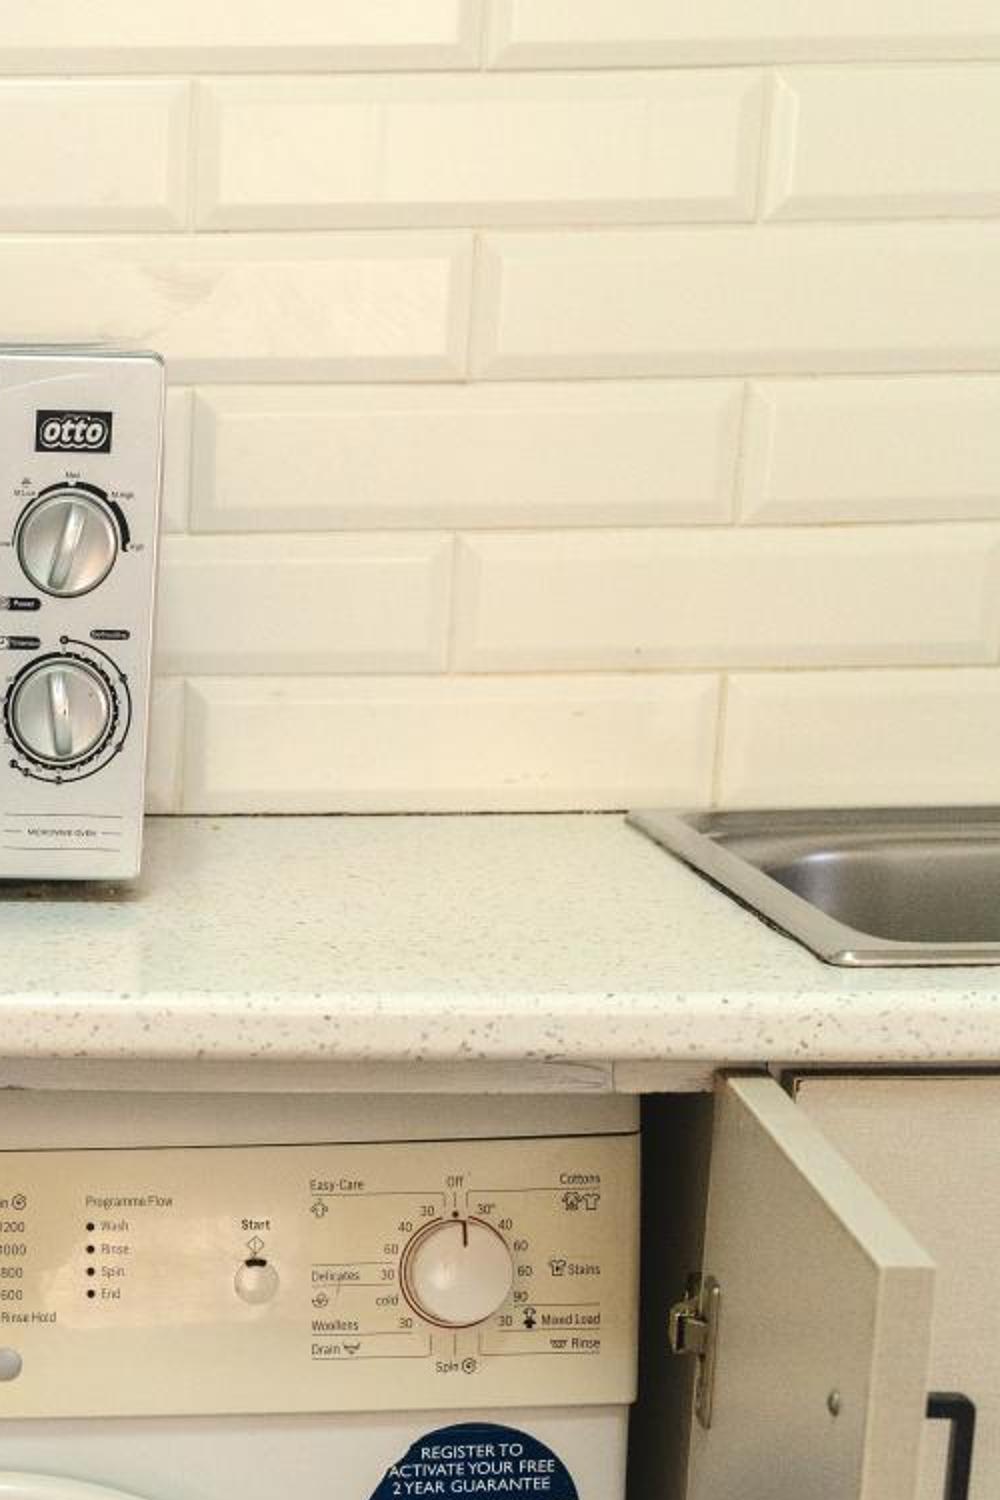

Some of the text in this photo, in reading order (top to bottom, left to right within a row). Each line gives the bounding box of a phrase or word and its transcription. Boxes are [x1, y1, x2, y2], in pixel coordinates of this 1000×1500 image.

[43, 417, 104, 443] otto
[310, 1179, 365, 1192] Easy-Care
[447, 1175, 464, 1188] Off
[559, 1174, 600, 1185] Cottons
[85, 1195, 173, 1210] Programme Flow
[421, 1205, 435, 1217] 30
[0, 1221, 26, 1233] 1200
[100, 1220, 129, 1232] Wash
[241, 1218, 271, 1231] Start
[398, 1221, 413, 1233] 40
[498, 1218, 513, 1230] 40
[0, 1244, 27, 1255] 1000
[100, 1243, 129, 1255] Rinse
[383, 1244, 398, 1255] 60
[513, 1239, 528, 1251] 60
[0, 1266, 23, 1278] 800
[100, 1266, 125, 1279] Spin
[311, 1268, 395, 1282] Delicates 30
[517, 1265, 533, 1277] 60
[567, 1263, 600, 1276] Stains
[0, 1289, 23, 1301] 600
[100, 1288, 121, 1300] End
[513, 1291, 528, 1303] 90
[375, 1295, 399, 1307] cold
[0, 1311, 57, 1323] Rinse Hold
[498, 1315, 513, 1327] 30
[541, 1313, 600, 1326] Mixed Load
[311, 1317, 413, 1332] Woollens 30
[311, 1343, 340, 1355] Drain
[570, 1337, 600, 1349] Rinse
[435, 1361, 459, 1374] Spin
[420, 1443, 524, 1460] REGISTER TO
[389, 1459, 556, 1478] ACTIVATE YOUR FREE
[392, 1476, 551, 1495] 2 YEAR GUARANTEE
